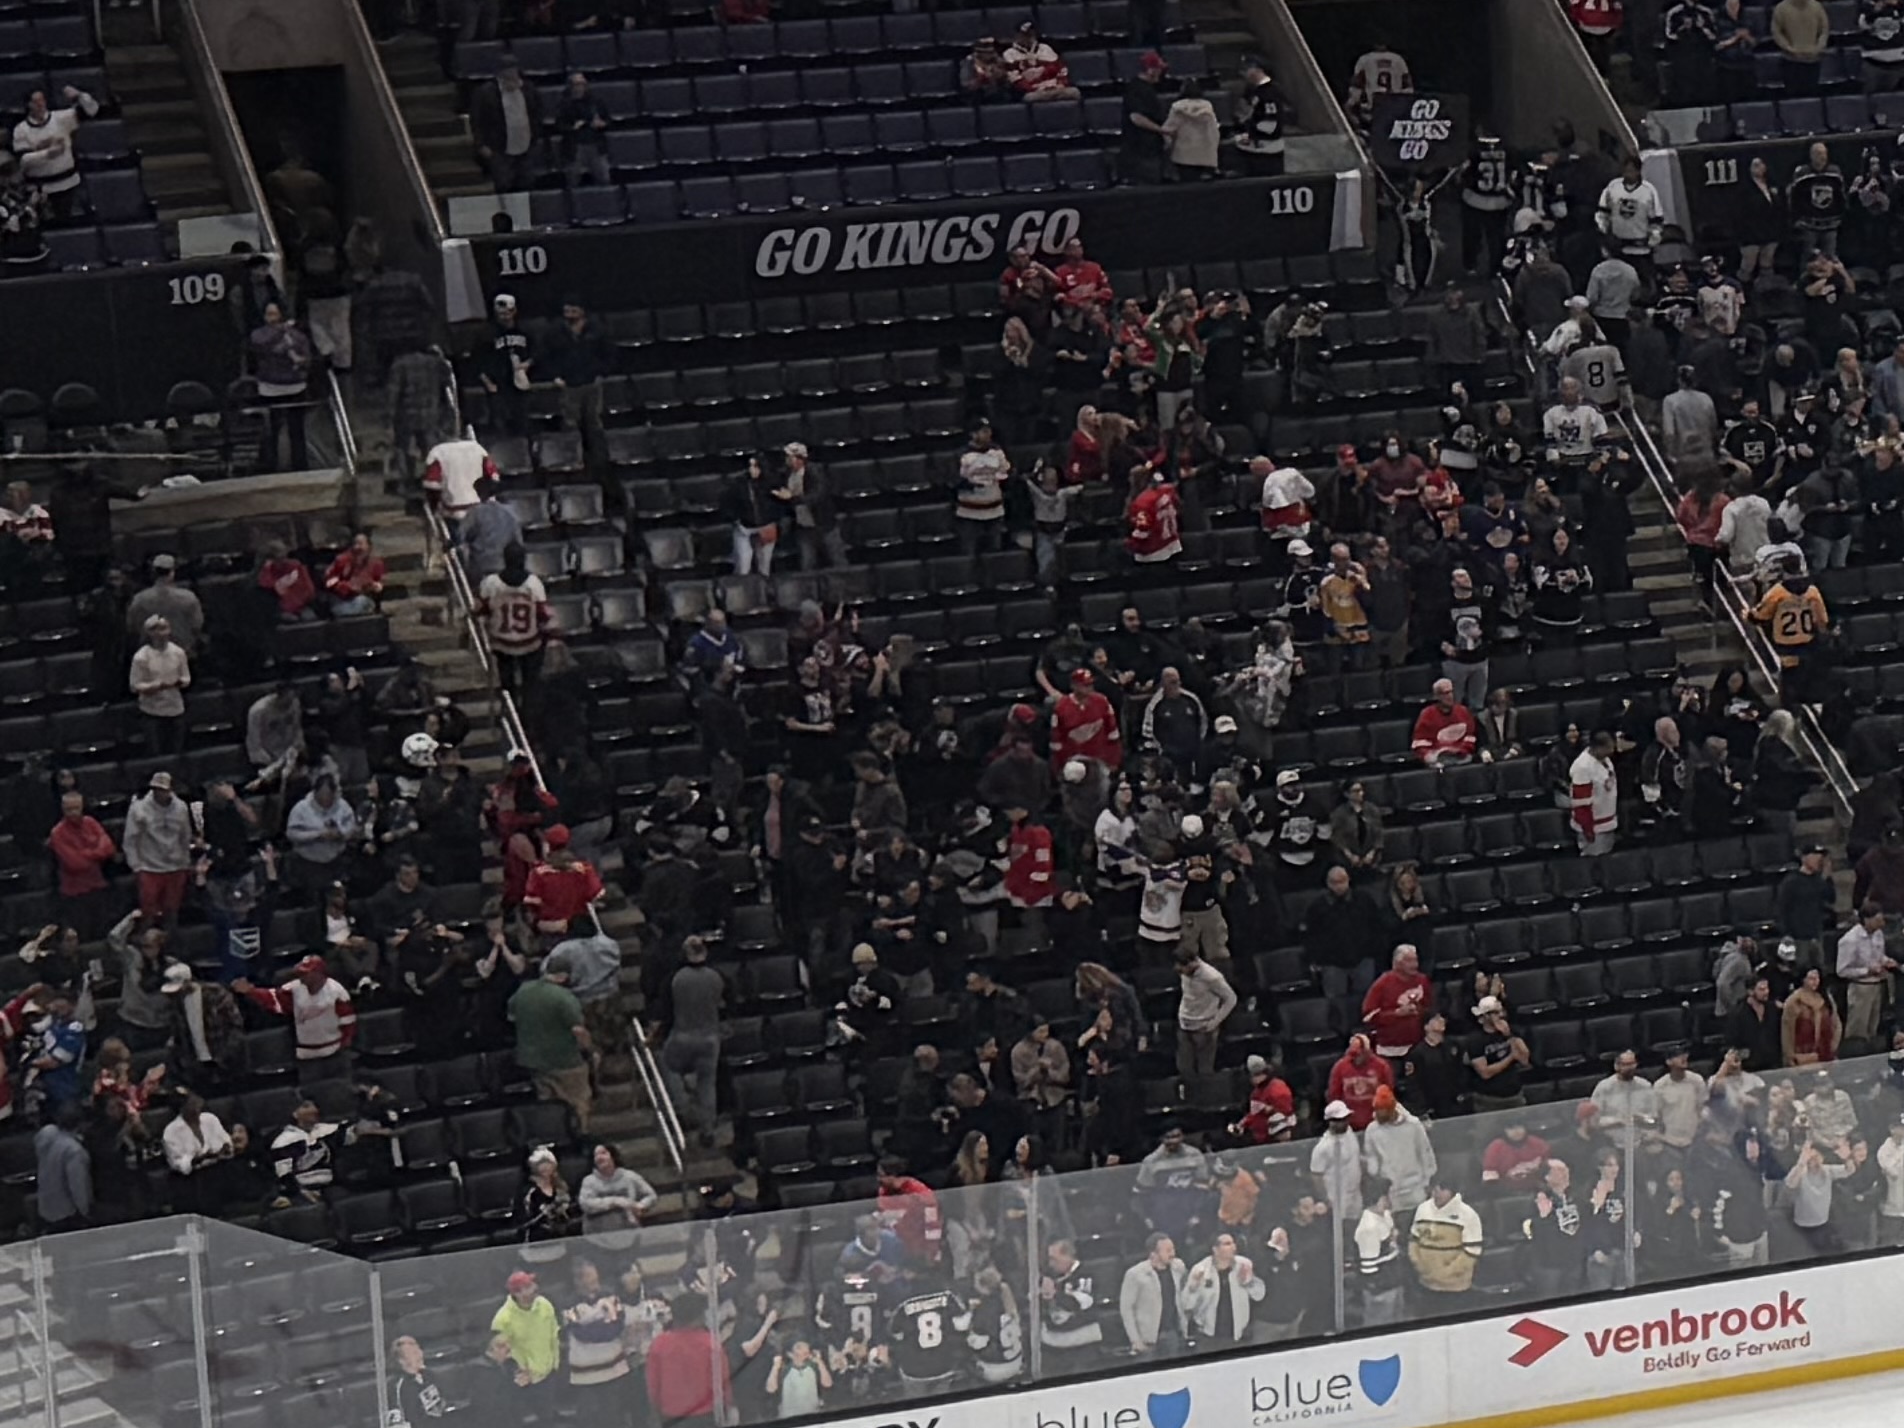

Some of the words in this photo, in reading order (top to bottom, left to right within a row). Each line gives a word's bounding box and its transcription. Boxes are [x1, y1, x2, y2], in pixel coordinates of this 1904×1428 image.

[1411, 99, 1440, 120] GO
[1389, 120, 1452, 140] KINGS
[1399, 140, 1429, 161] GO
[1704, 158, 1738, 185] 111
[1270, 187, 1314, 215] 110
[756, 226, 830, 278] GO
[836, 211, 1001, 273] KINGS
[1005, 209, 1081, 256] GO
[498, 246, 547, 275] 110
[169, 272, 225, 305] 109
[1587, 360, 1606, 388] 8
[1781, 609, 1814, 637] 20
[916, 1311, 942, 1350] 8
[1584, 1289, 1808, 1359] venbrook
[1642, 1350, 1701, 1375] Boldly
[1705, 1344, 1732, 1364] Go
[1736, 1331, 1812, 1358] Forward
[1252, 1372, 1353, 1414] blue
